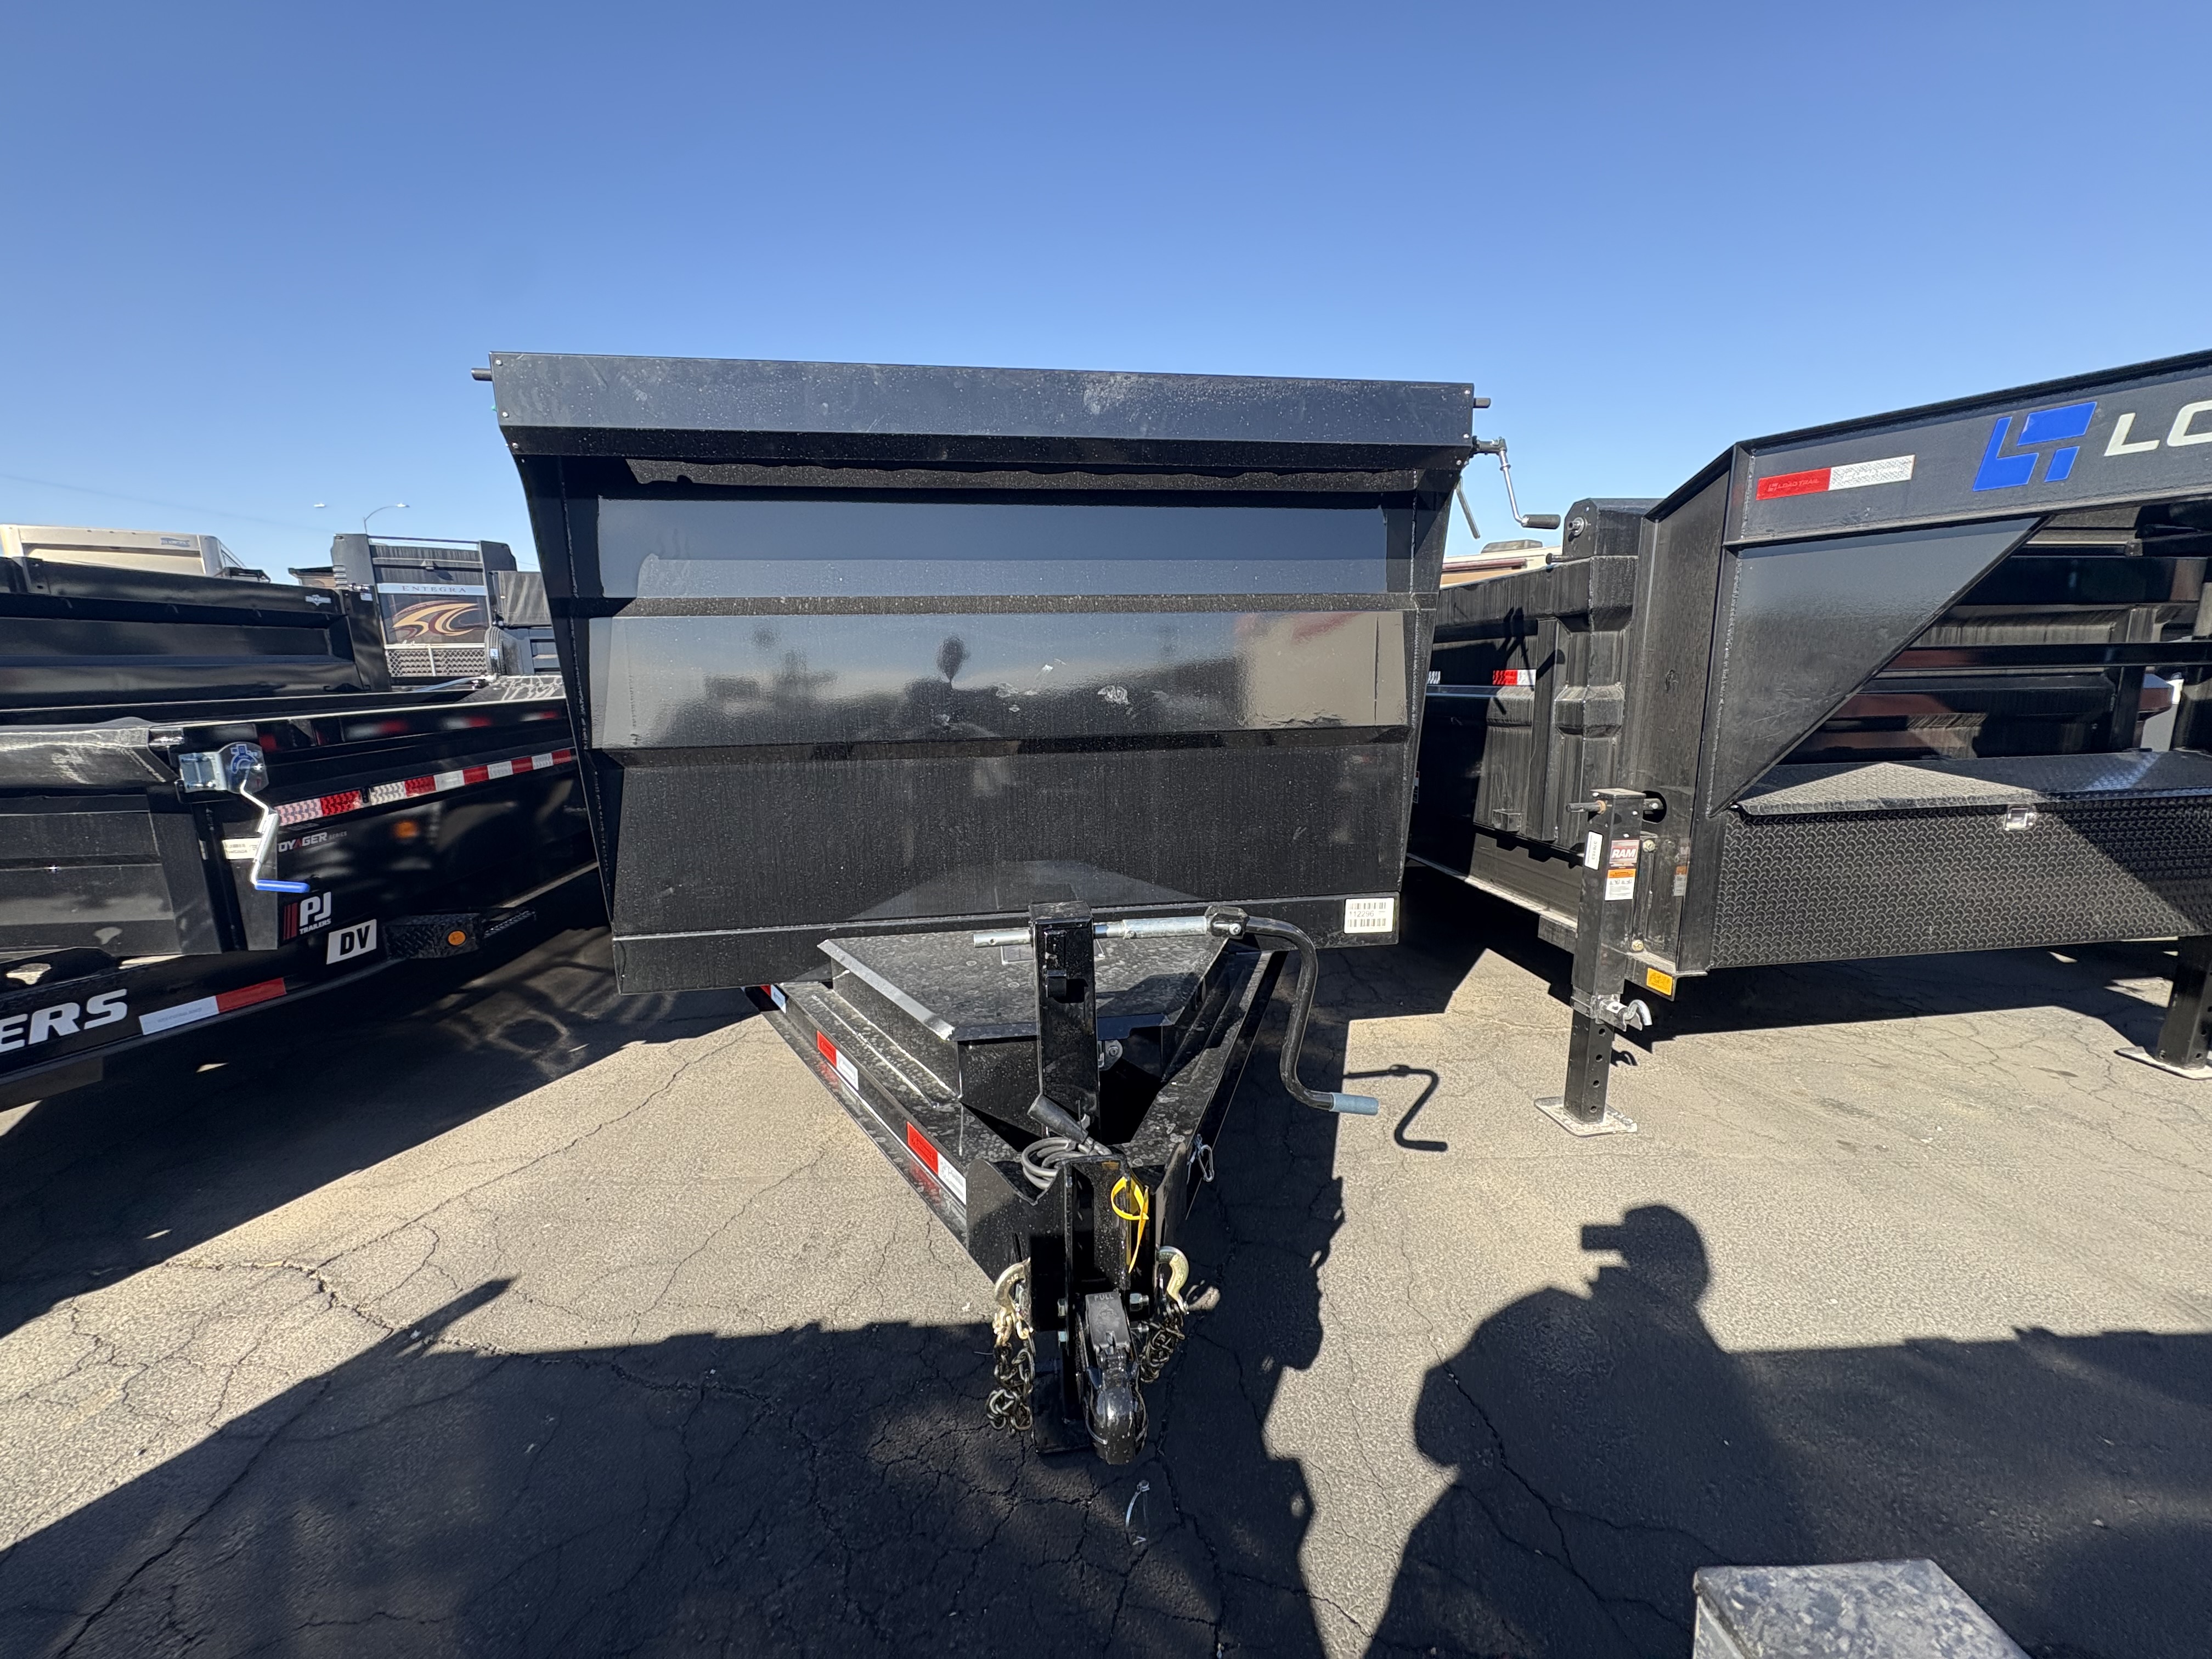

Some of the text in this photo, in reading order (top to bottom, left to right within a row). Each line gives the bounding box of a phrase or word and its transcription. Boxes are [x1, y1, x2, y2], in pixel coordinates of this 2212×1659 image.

[278, 832, 328, 852] OYAGER
[1612, 849, 1636, 858] RAM
[300, 891, 331, 927] PJ
[299, 918, 331, 934] TRAILERS
[340, 924, 370, 956] DV
[0, 989, 128, 1052] ERS
